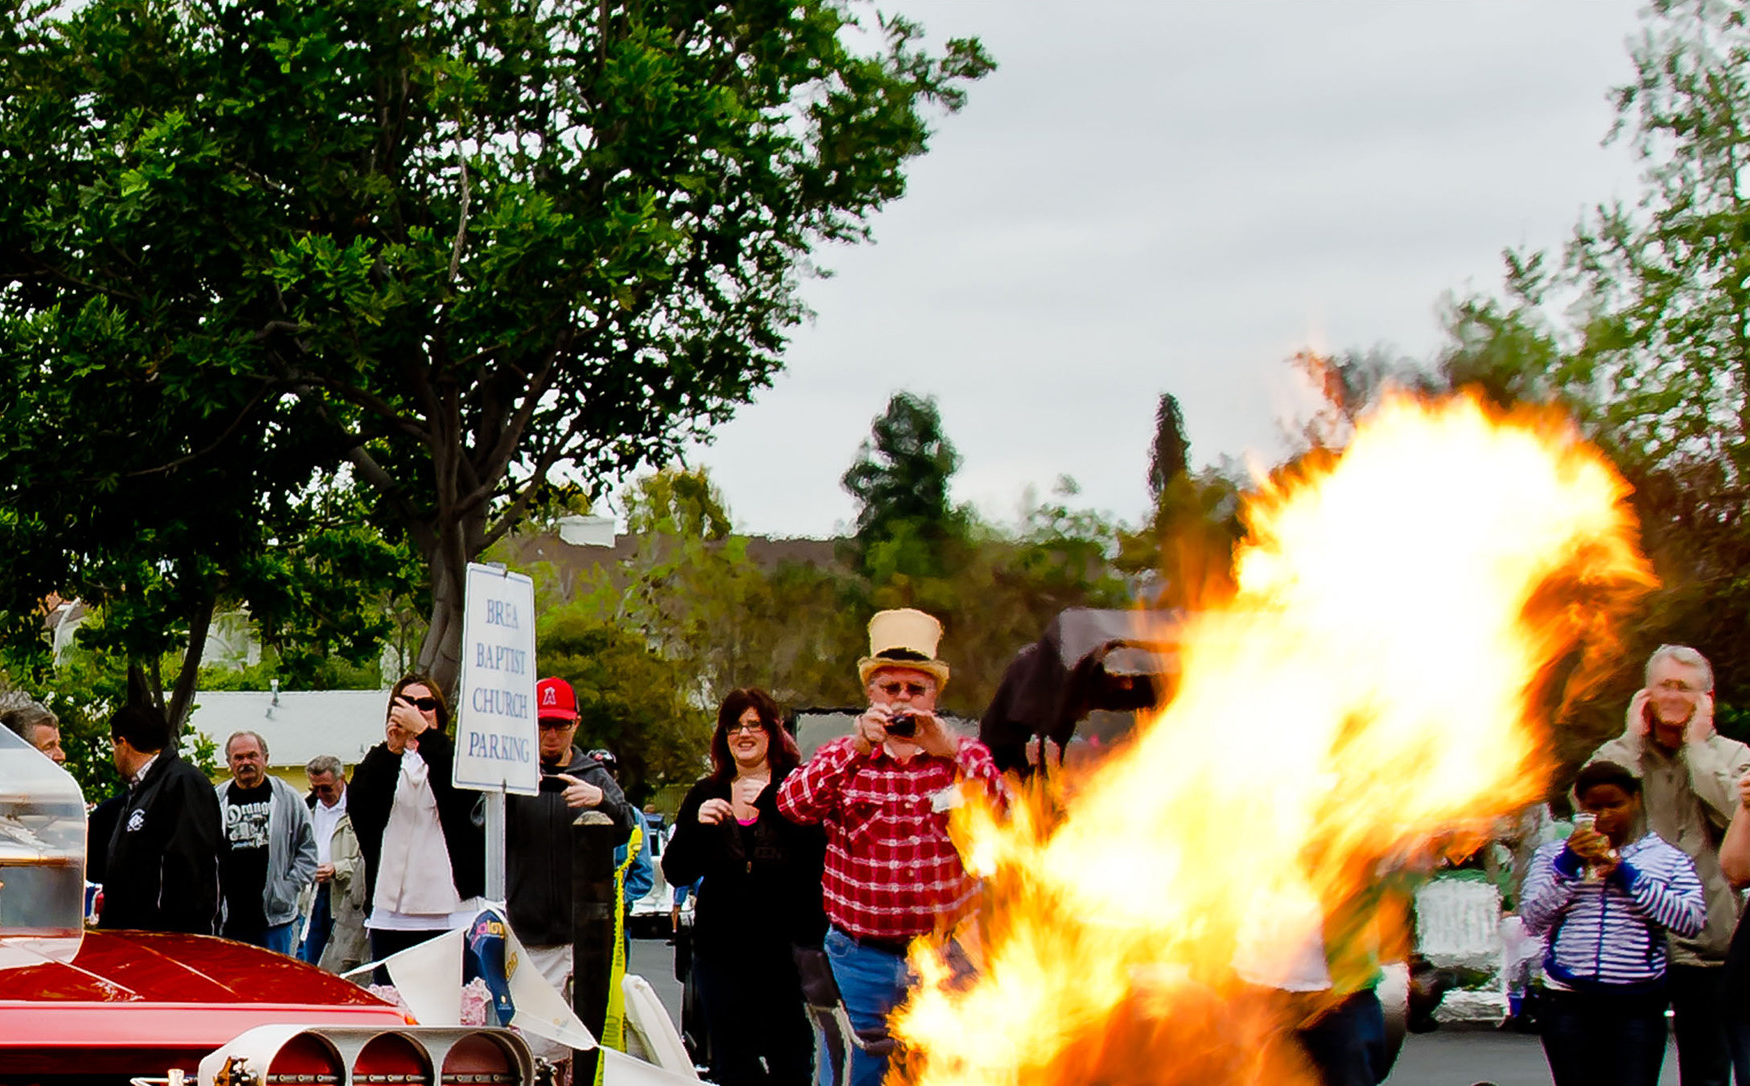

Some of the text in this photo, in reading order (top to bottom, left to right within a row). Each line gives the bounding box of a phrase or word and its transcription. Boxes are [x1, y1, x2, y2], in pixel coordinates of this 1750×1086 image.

[486, 599, 519, 629] BREA
[475, 642, 526, 676] BAPTIST
[472, 687, 528, 719] CHURCH
[468, 732, 529, 763] PARKING
[227, 801, 270, 827] Orang
